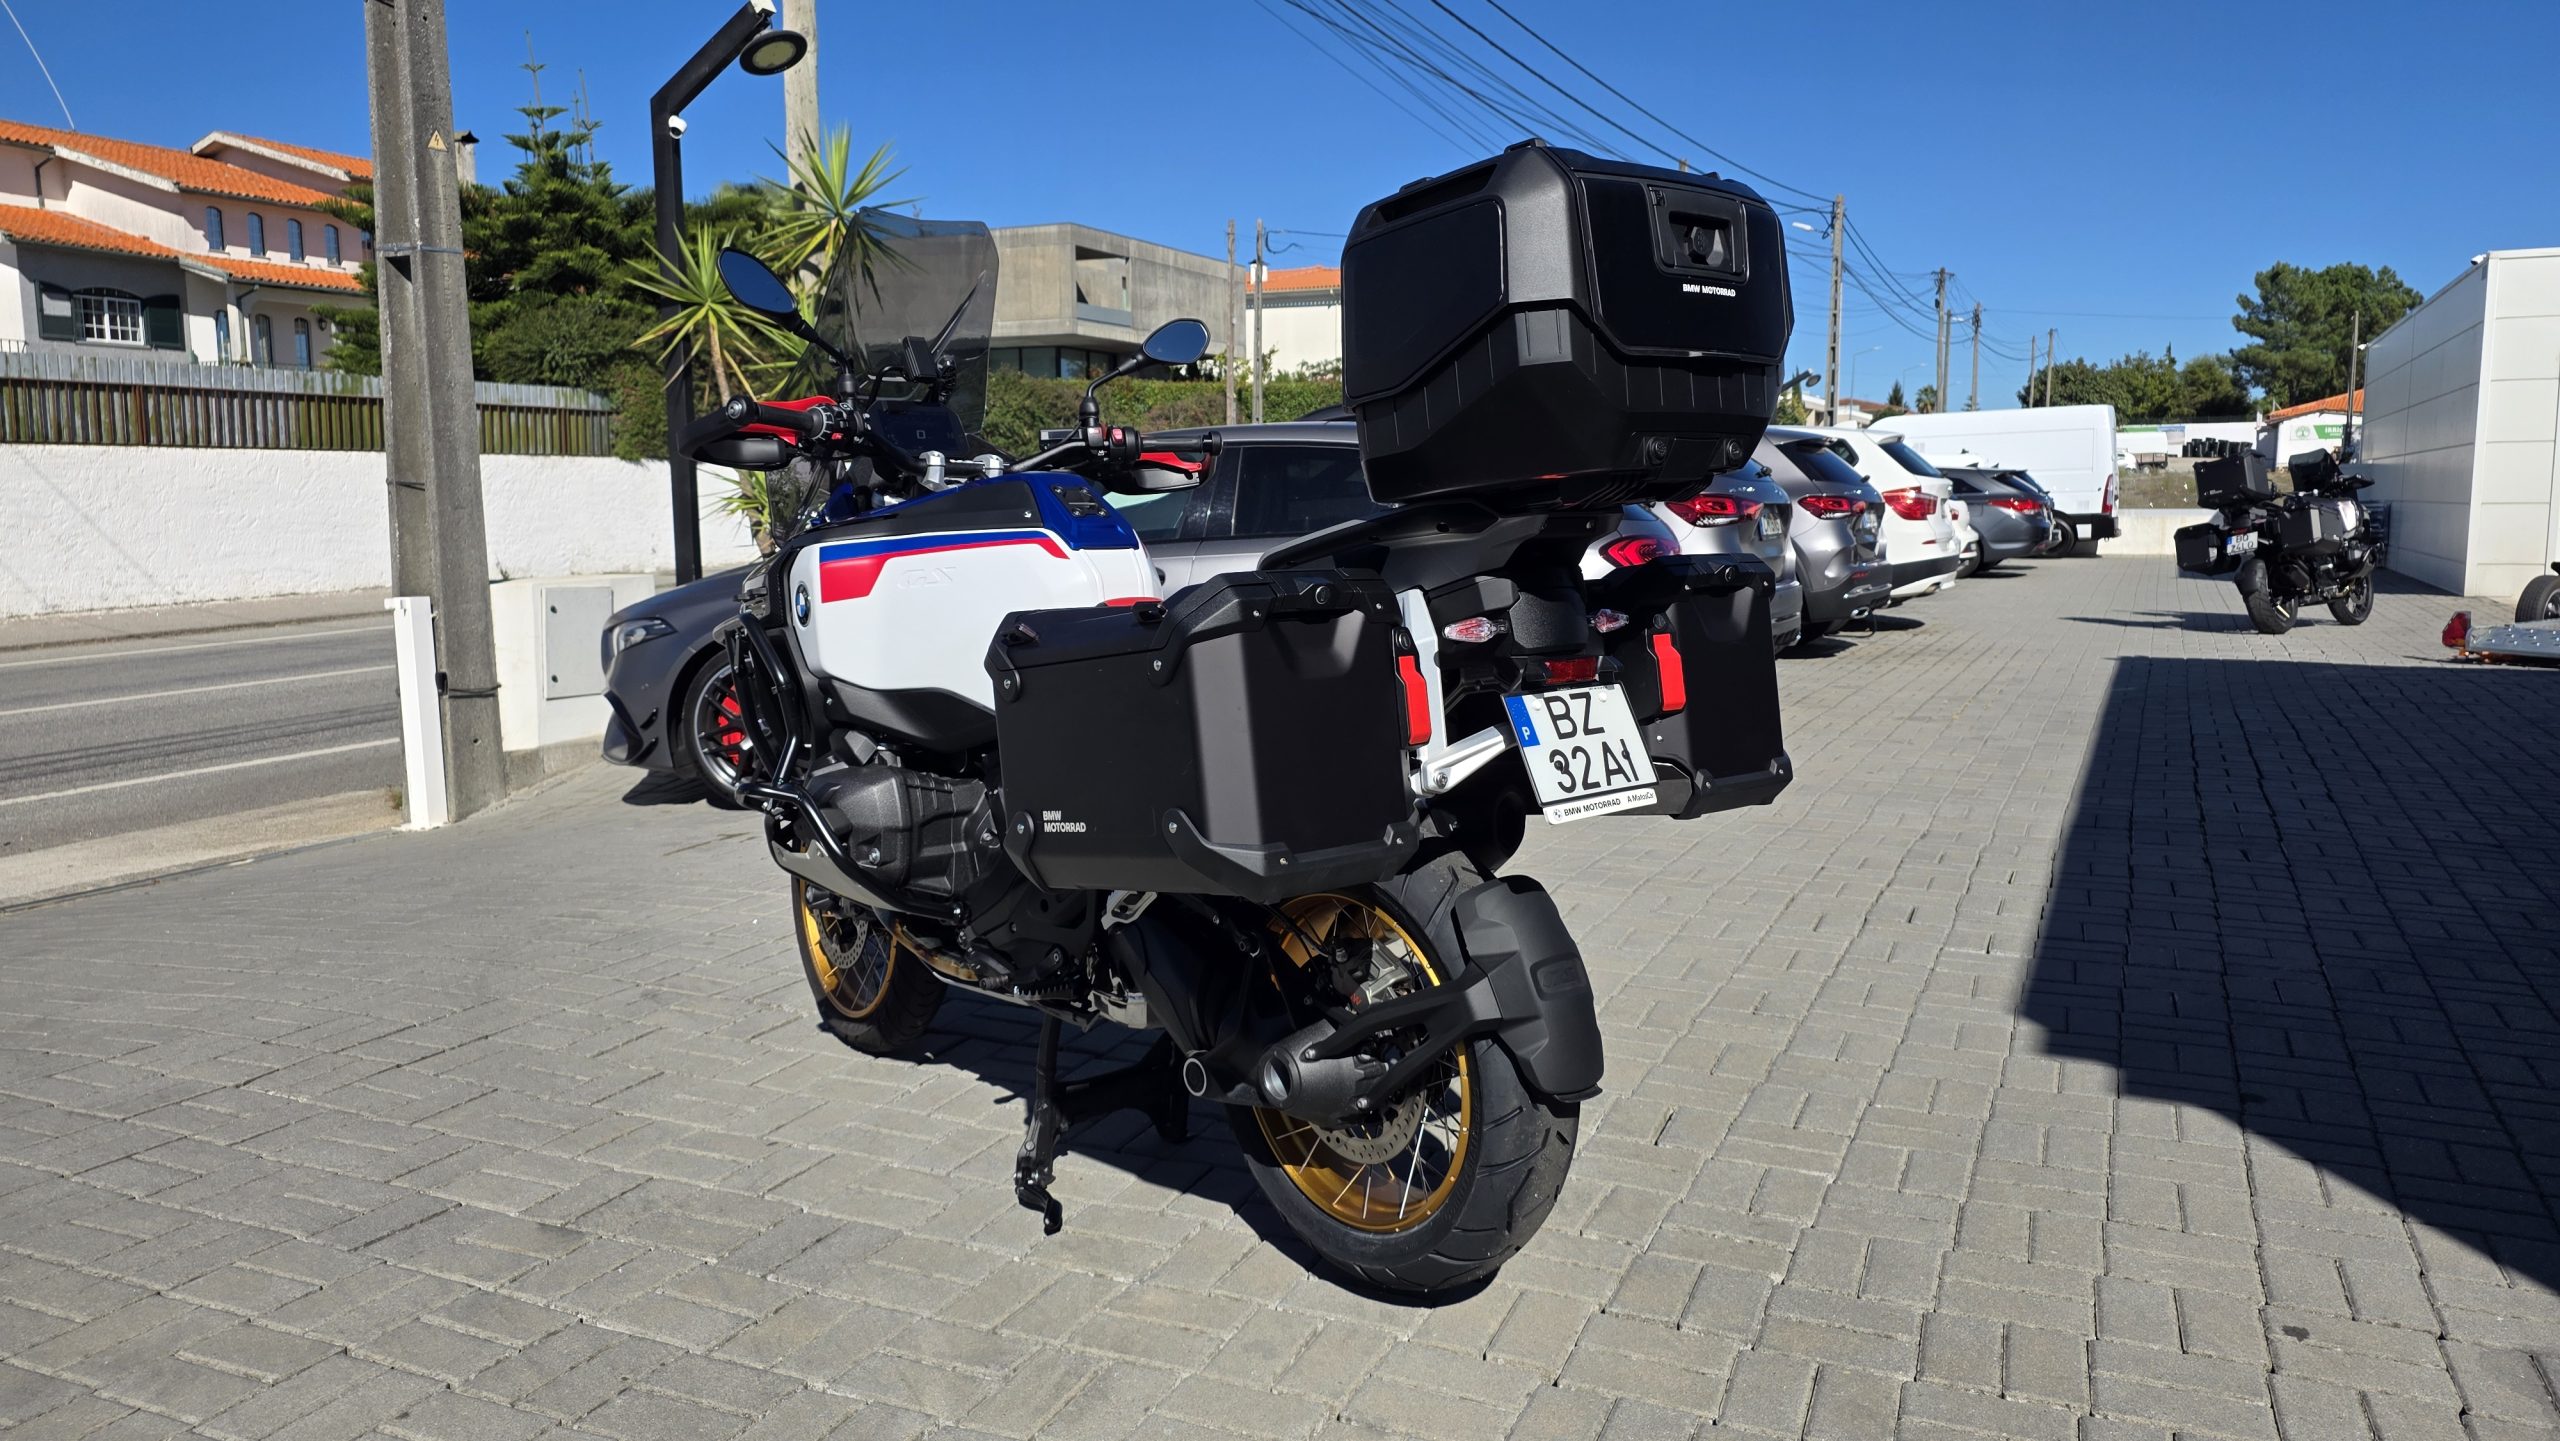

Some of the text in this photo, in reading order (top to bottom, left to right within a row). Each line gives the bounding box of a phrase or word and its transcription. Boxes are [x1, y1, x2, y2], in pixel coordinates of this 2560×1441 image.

[1682, 284, 1736, 297] BMW MOTORRAD
[1543, 691, 1606, 740] BZ
[1521, 726, 1531, 741] P
[1564, 805, 1582, 817] BMW
[1583, 798, 1621, 813] MOTORRAD
[1042, 810, 1062, 821] BMW
[1044, 822, 1087, 833] MOTORRAD
